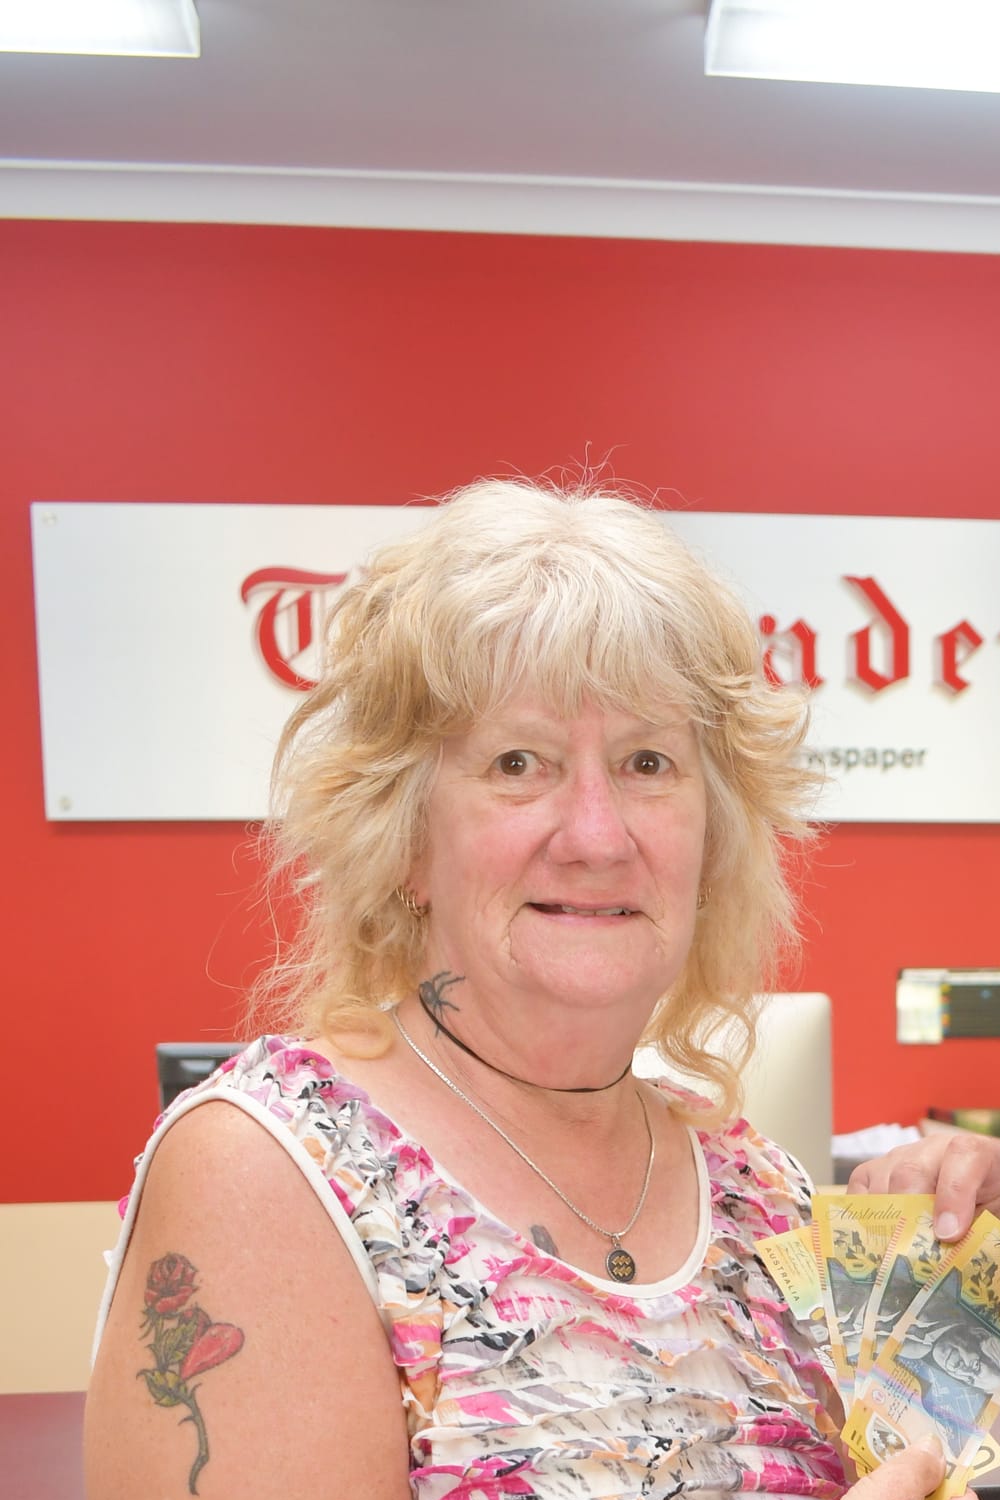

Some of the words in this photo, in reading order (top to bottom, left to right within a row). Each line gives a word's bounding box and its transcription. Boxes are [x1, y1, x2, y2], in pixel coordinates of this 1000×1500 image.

[806, 745, 927, 771] wspaper
[826, 1202, 903, 1221] Australia
[765, 1246, 801, 1303] AUSTRALIA
